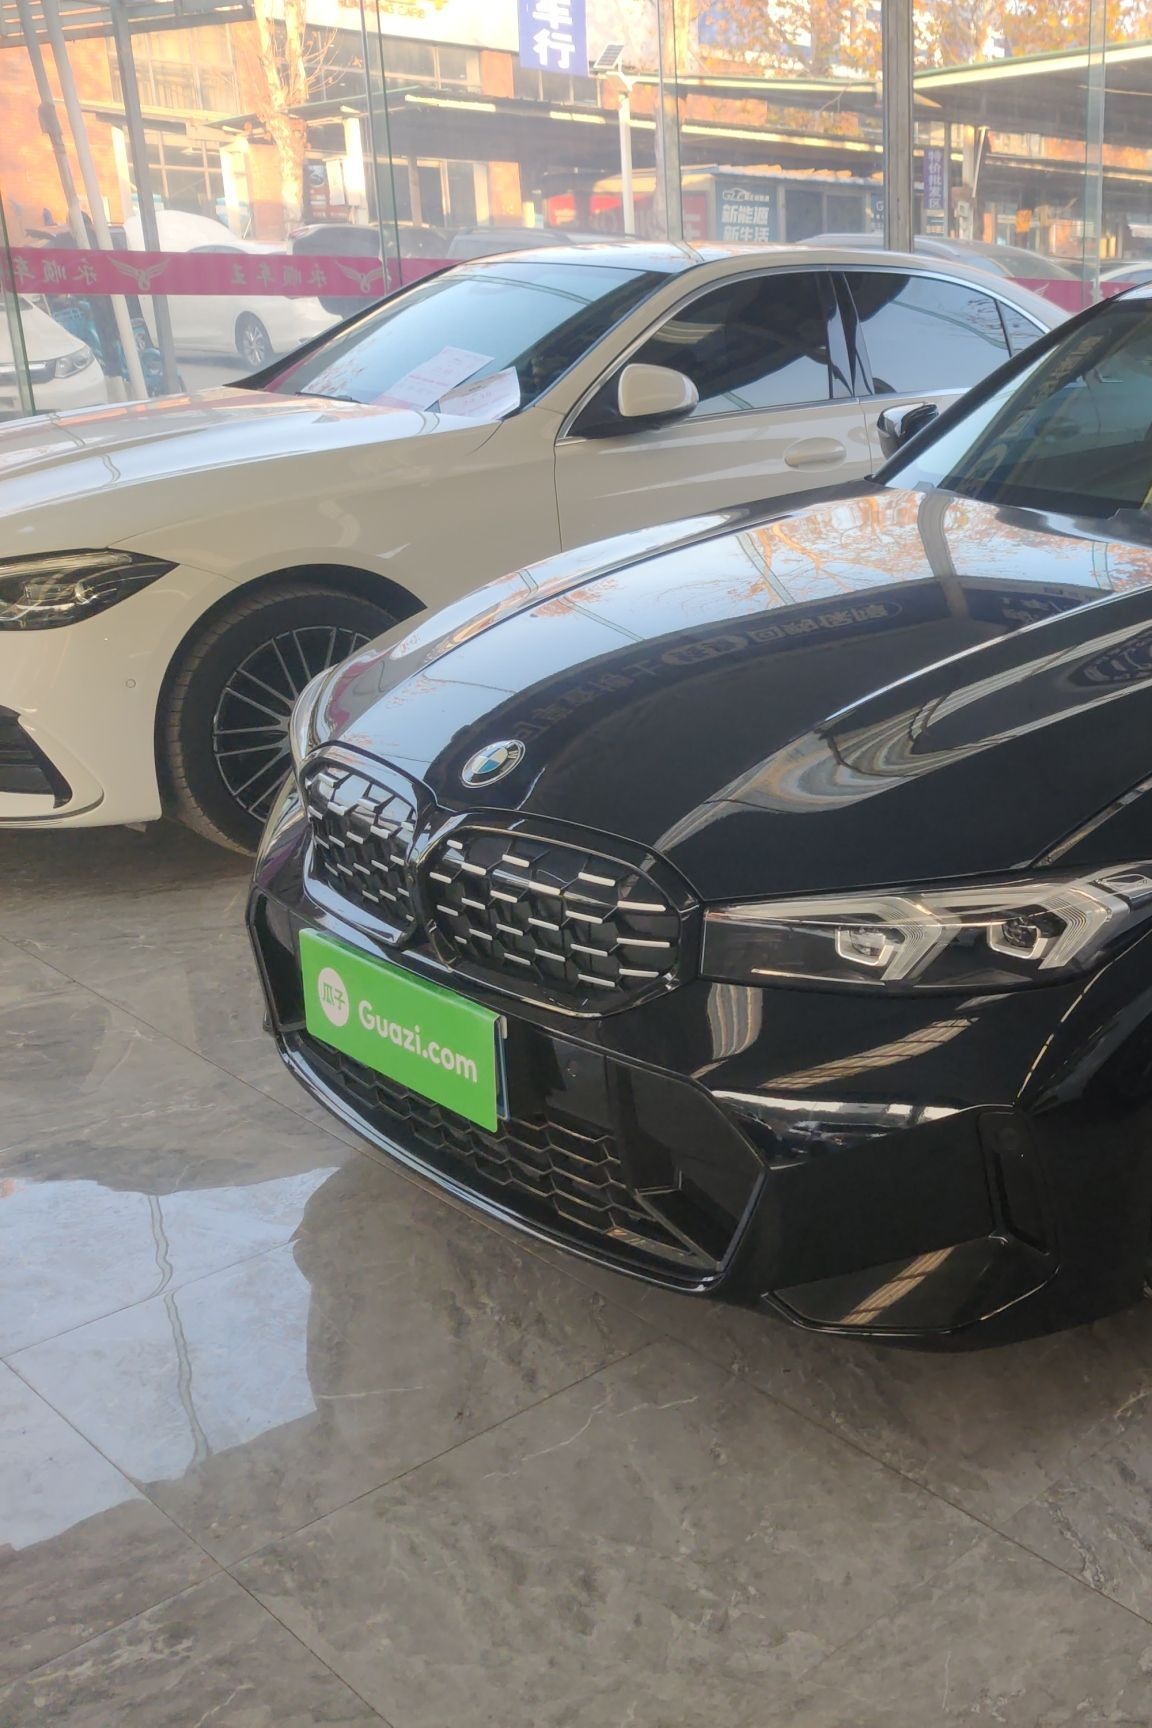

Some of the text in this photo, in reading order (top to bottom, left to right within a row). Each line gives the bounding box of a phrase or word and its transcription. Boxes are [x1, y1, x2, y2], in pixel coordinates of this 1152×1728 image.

[722, 204, 769, 224] 新能源
[322, 982, 345, 1011] 瓜子
[358, 1000, 478, 1083] Guazi.com
